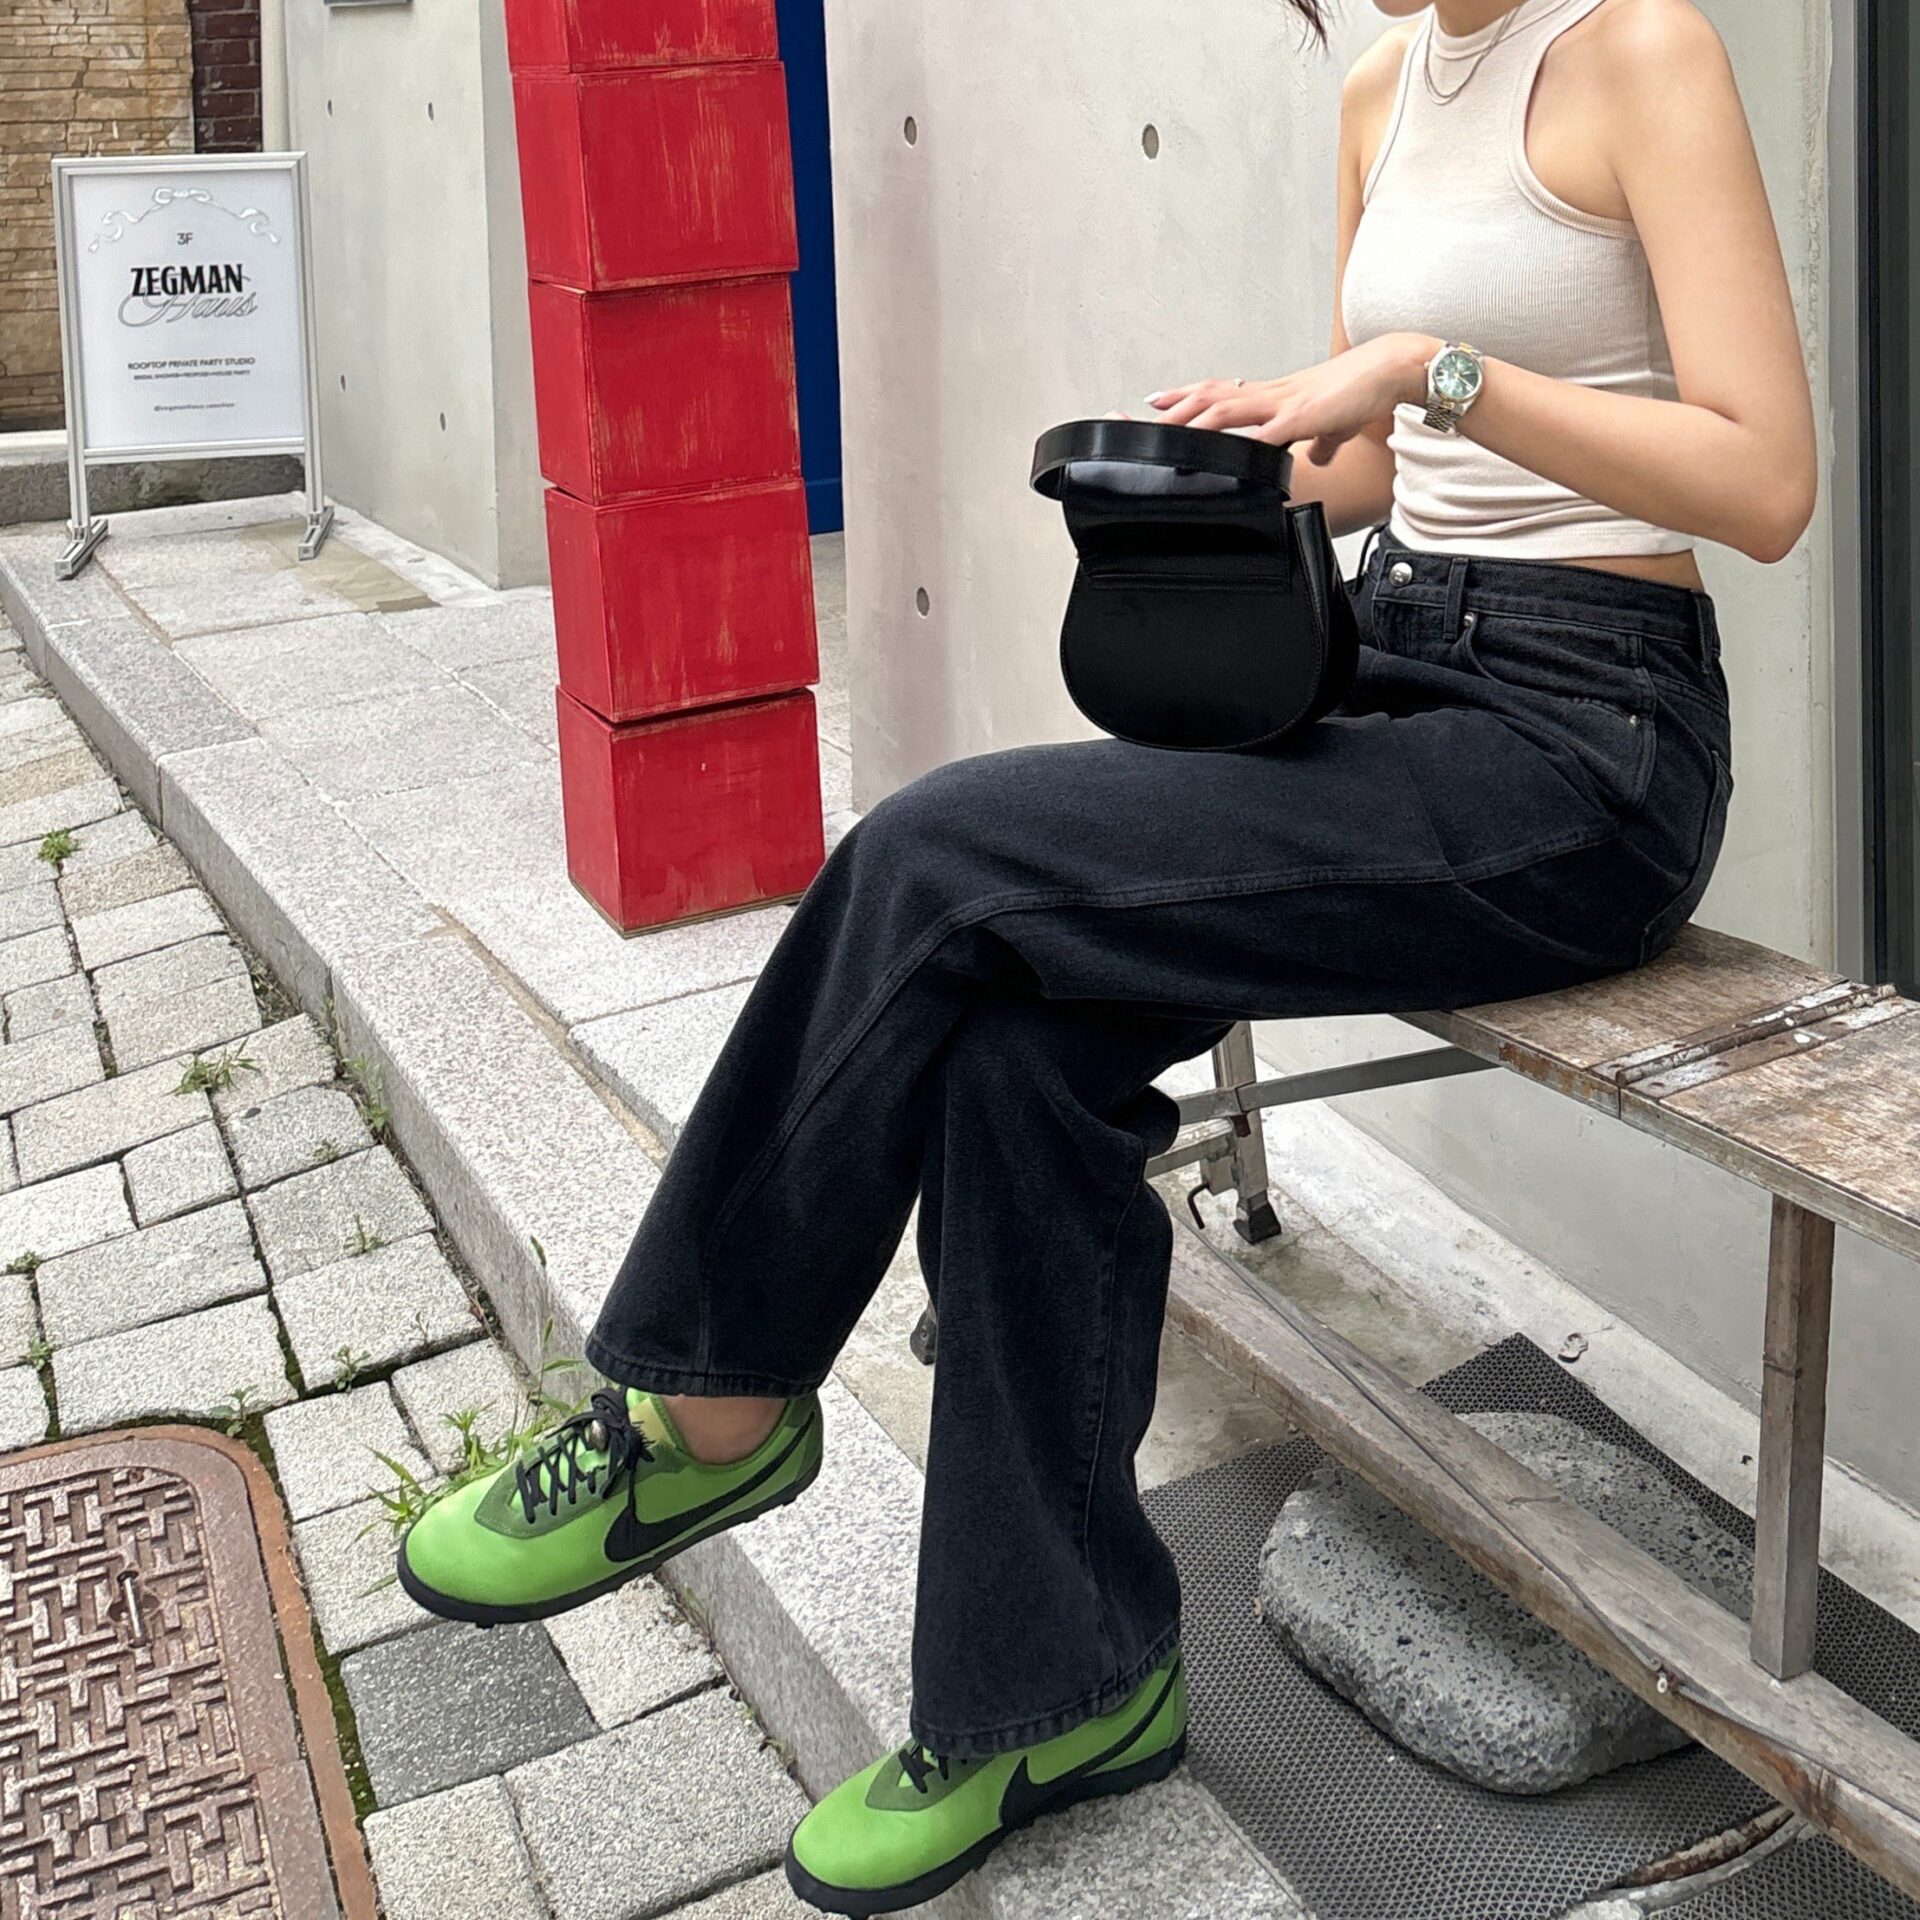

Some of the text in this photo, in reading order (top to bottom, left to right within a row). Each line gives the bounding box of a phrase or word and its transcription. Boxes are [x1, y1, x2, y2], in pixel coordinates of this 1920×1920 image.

[177, 232, 194, 245] 3F
[130, 263, 244, 297] ZEGMAN
[118, 279, 258, 327] Haus
[127, 357, 256, 370] ROOFTOP PRIVATE PARTY STUDIO
